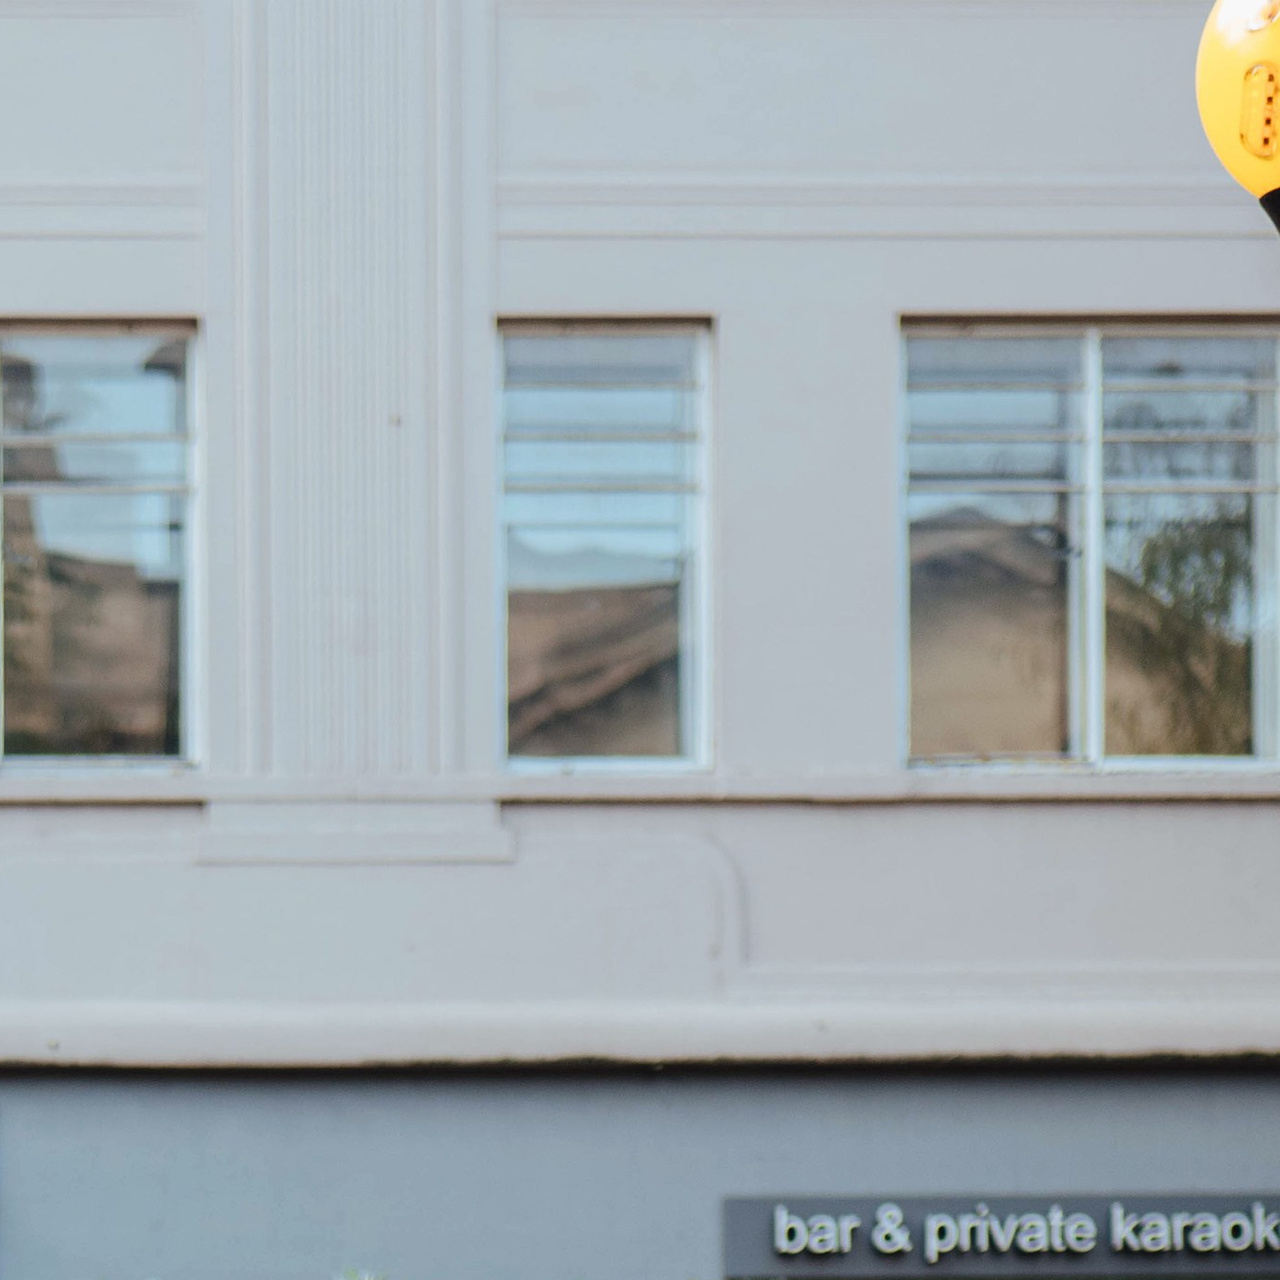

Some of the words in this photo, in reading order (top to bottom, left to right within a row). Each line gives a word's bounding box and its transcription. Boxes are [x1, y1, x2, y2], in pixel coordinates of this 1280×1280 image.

[774, 1204, 861, 1255] bar
[872, 1203, 913, 1254] &
[925, 1203, 1097, 1264] private
